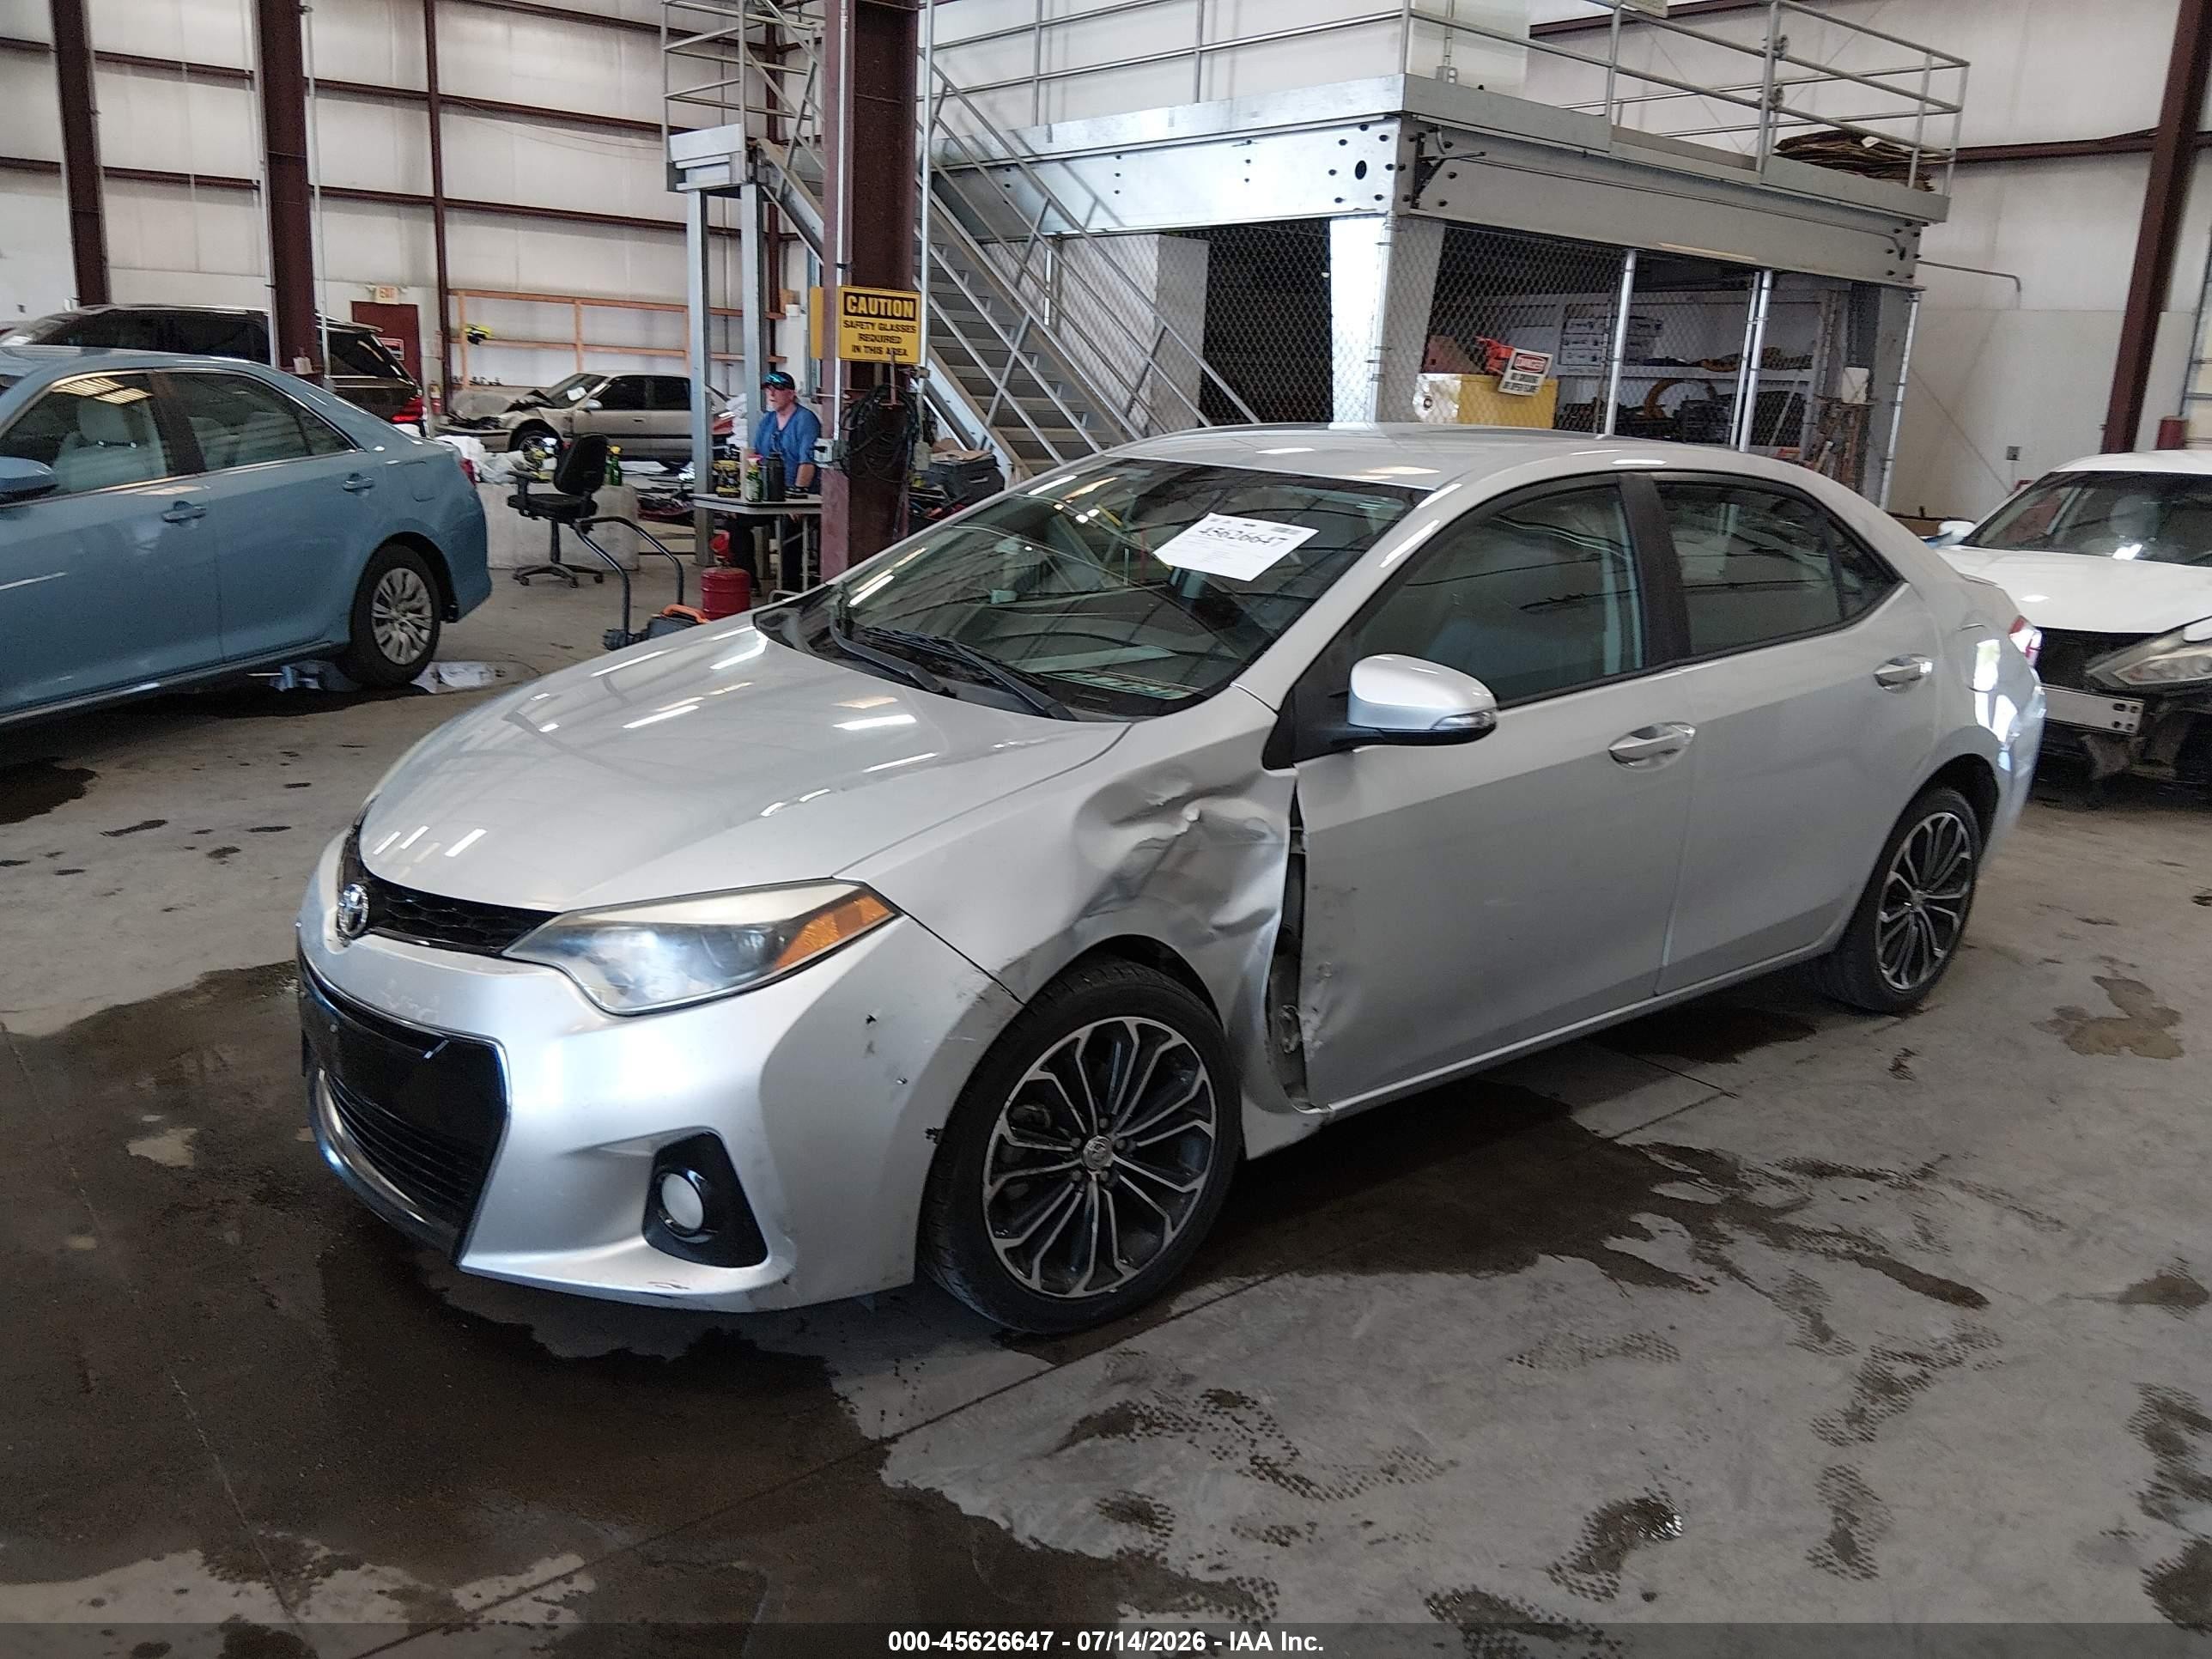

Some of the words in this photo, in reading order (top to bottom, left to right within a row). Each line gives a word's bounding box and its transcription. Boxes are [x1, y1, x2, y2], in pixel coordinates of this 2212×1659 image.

[846, 295, 915, 318] CAUTION
[843, 319, 875, 330] SAFETY
[878, 323, 917, 333] GLASSES
[858, 333, 902, 344] REQUIRED
[851, 344, 861, 353] IN
[863, 345, 884, 355] THIS
